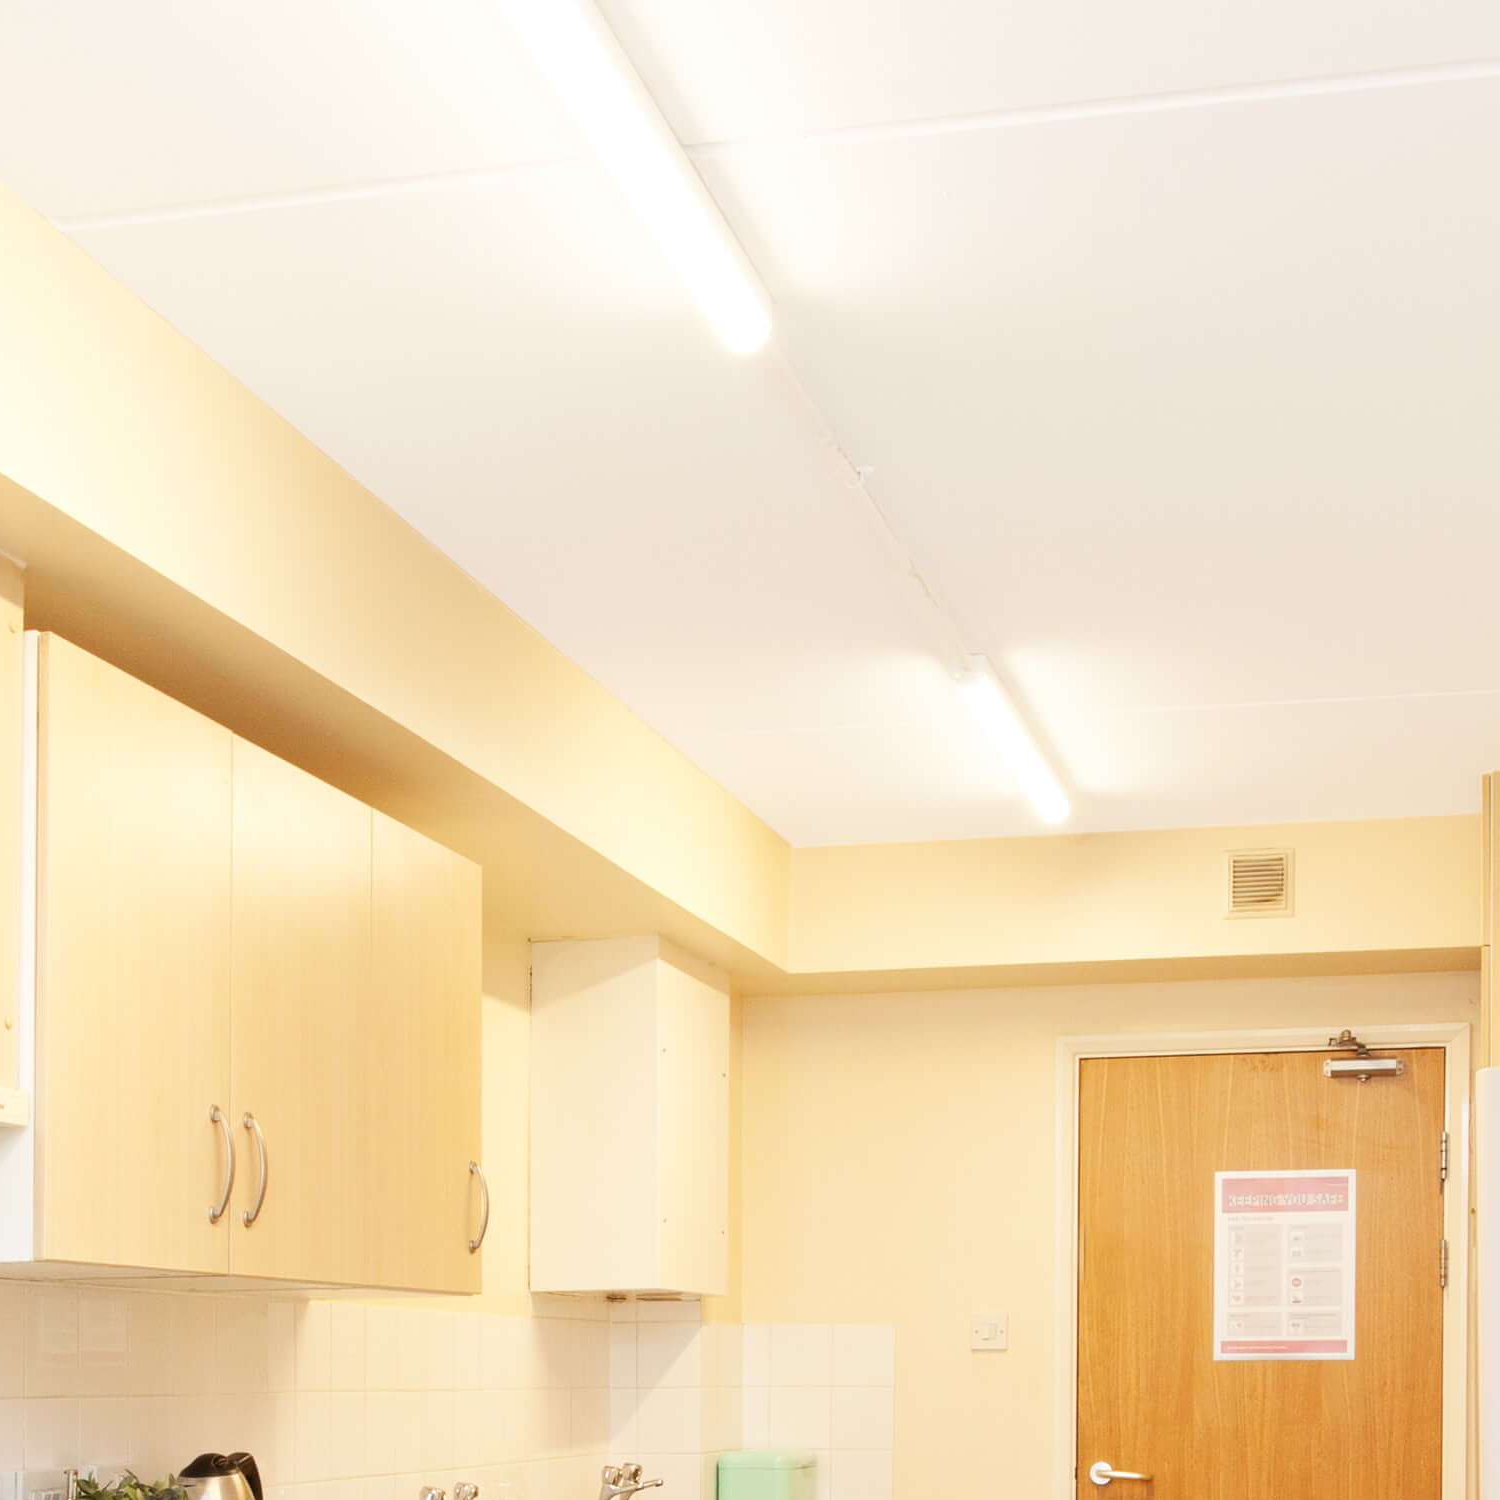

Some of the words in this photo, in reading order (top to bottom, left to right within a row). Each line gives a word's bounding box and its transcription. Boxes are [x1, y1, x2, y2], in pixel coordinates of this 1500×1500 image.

[1228, 1193, 1278, 1207] KEEPING
[1284, 1192, 1309, 1206] YOU
[1314, 1191, 1344, 1205] SAFE
